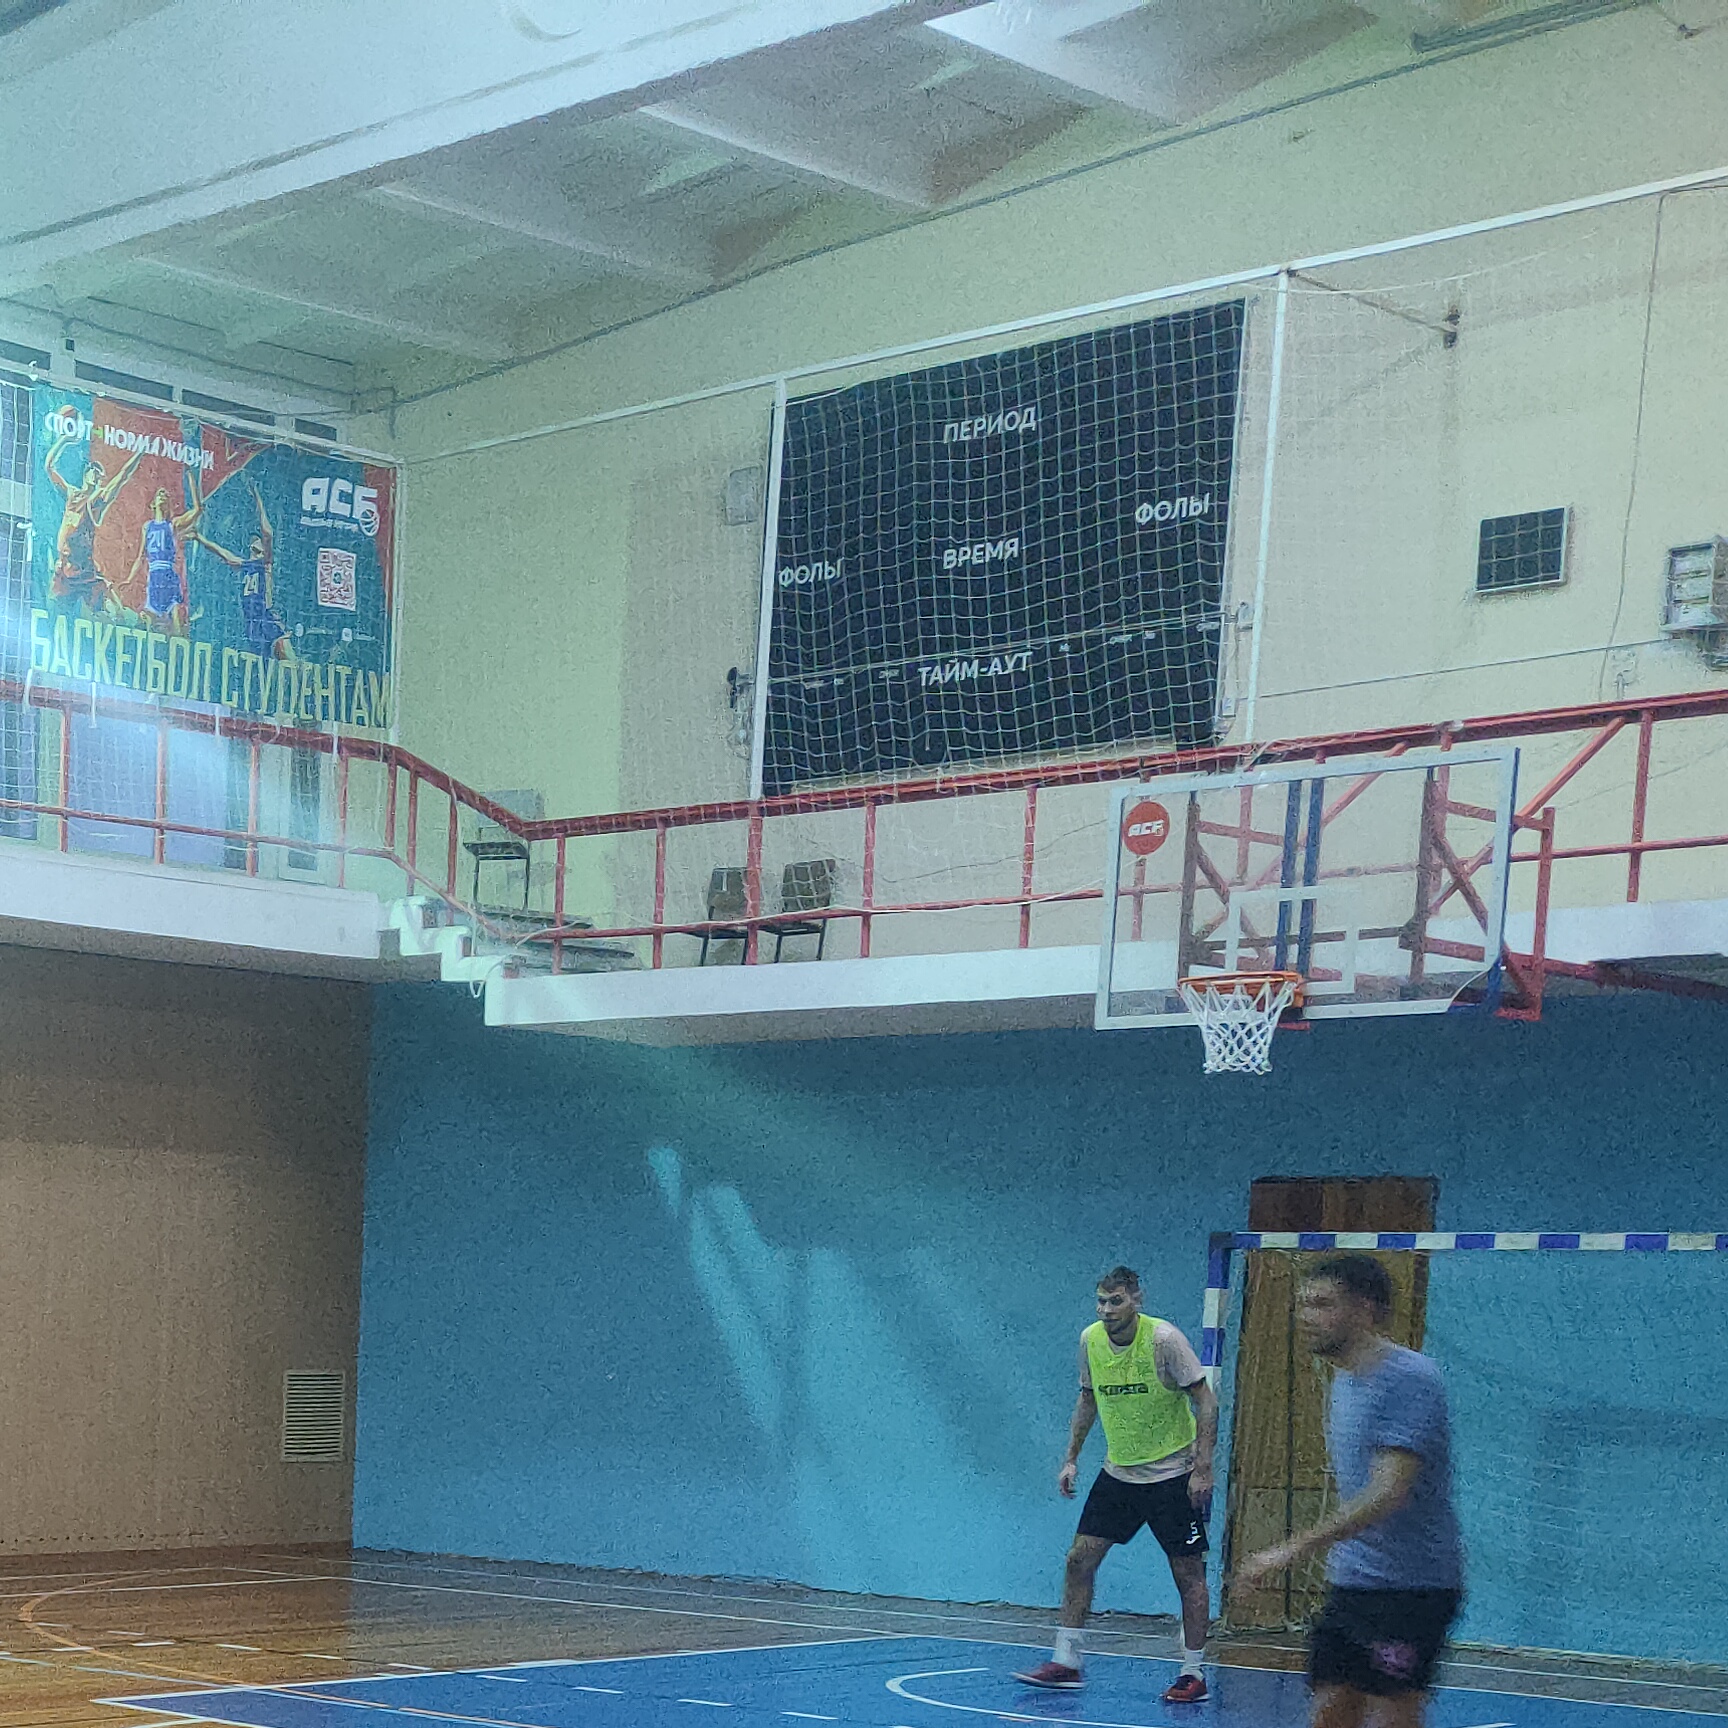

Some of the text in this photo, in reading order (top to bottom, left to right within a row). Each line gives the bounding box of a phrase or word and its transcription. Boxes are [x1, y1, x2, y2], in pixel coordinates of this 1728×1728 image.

[943, 405, 1038, 444] ПЕРИОД
[1134, 492, 1212, 526] ФОЛЫ
[942, 537, 1021, 570] ВРЕМЯ
[777, 557, 843, 588] ФОЛЫ
[30, 608, 392, 729] БАСКЕТБОЛ СТУДЕНТАМ
[918, 651, 1033, 687] ТАЙМ-АУТ
